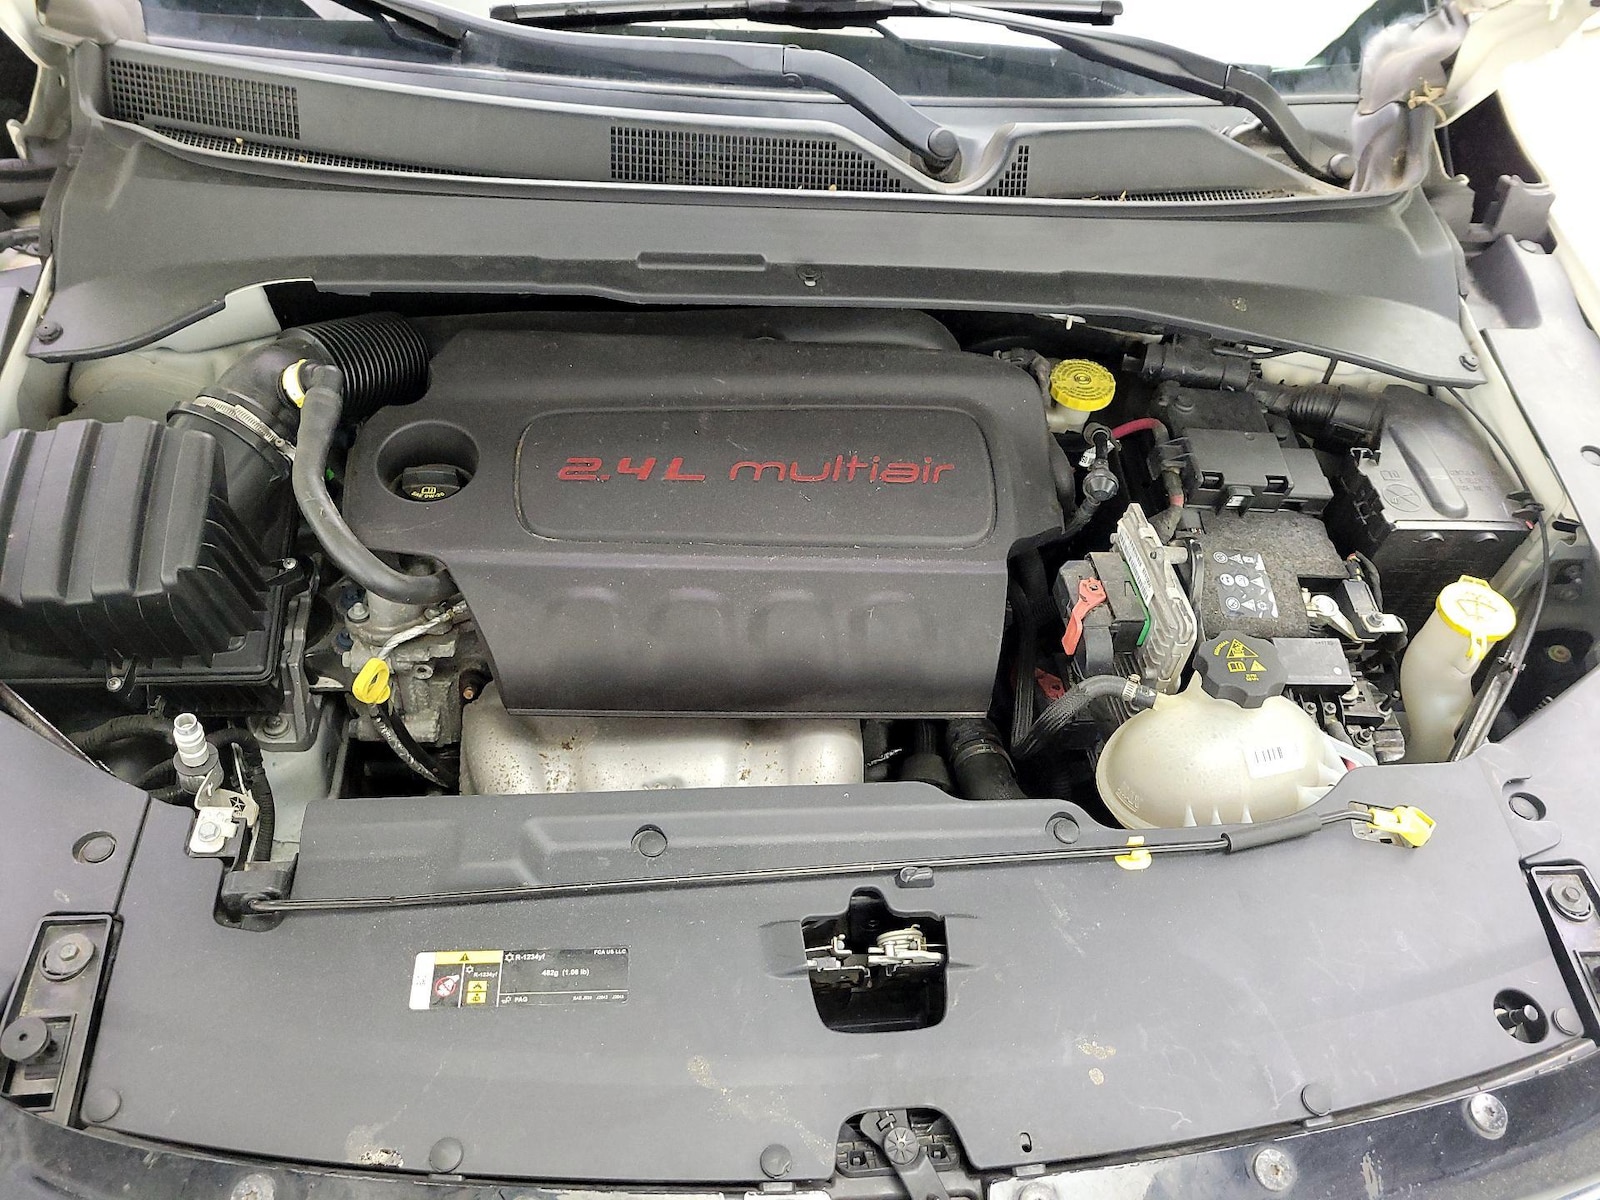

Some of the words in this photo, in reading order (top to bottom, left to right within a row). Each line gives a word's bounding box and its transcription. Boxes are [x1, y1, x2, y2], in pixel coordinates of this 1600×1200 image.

[729, 454, 956, 484] multiair
[515, 952, 546, 962] R-1234yf
[580, 968, 590, 977] lb)
